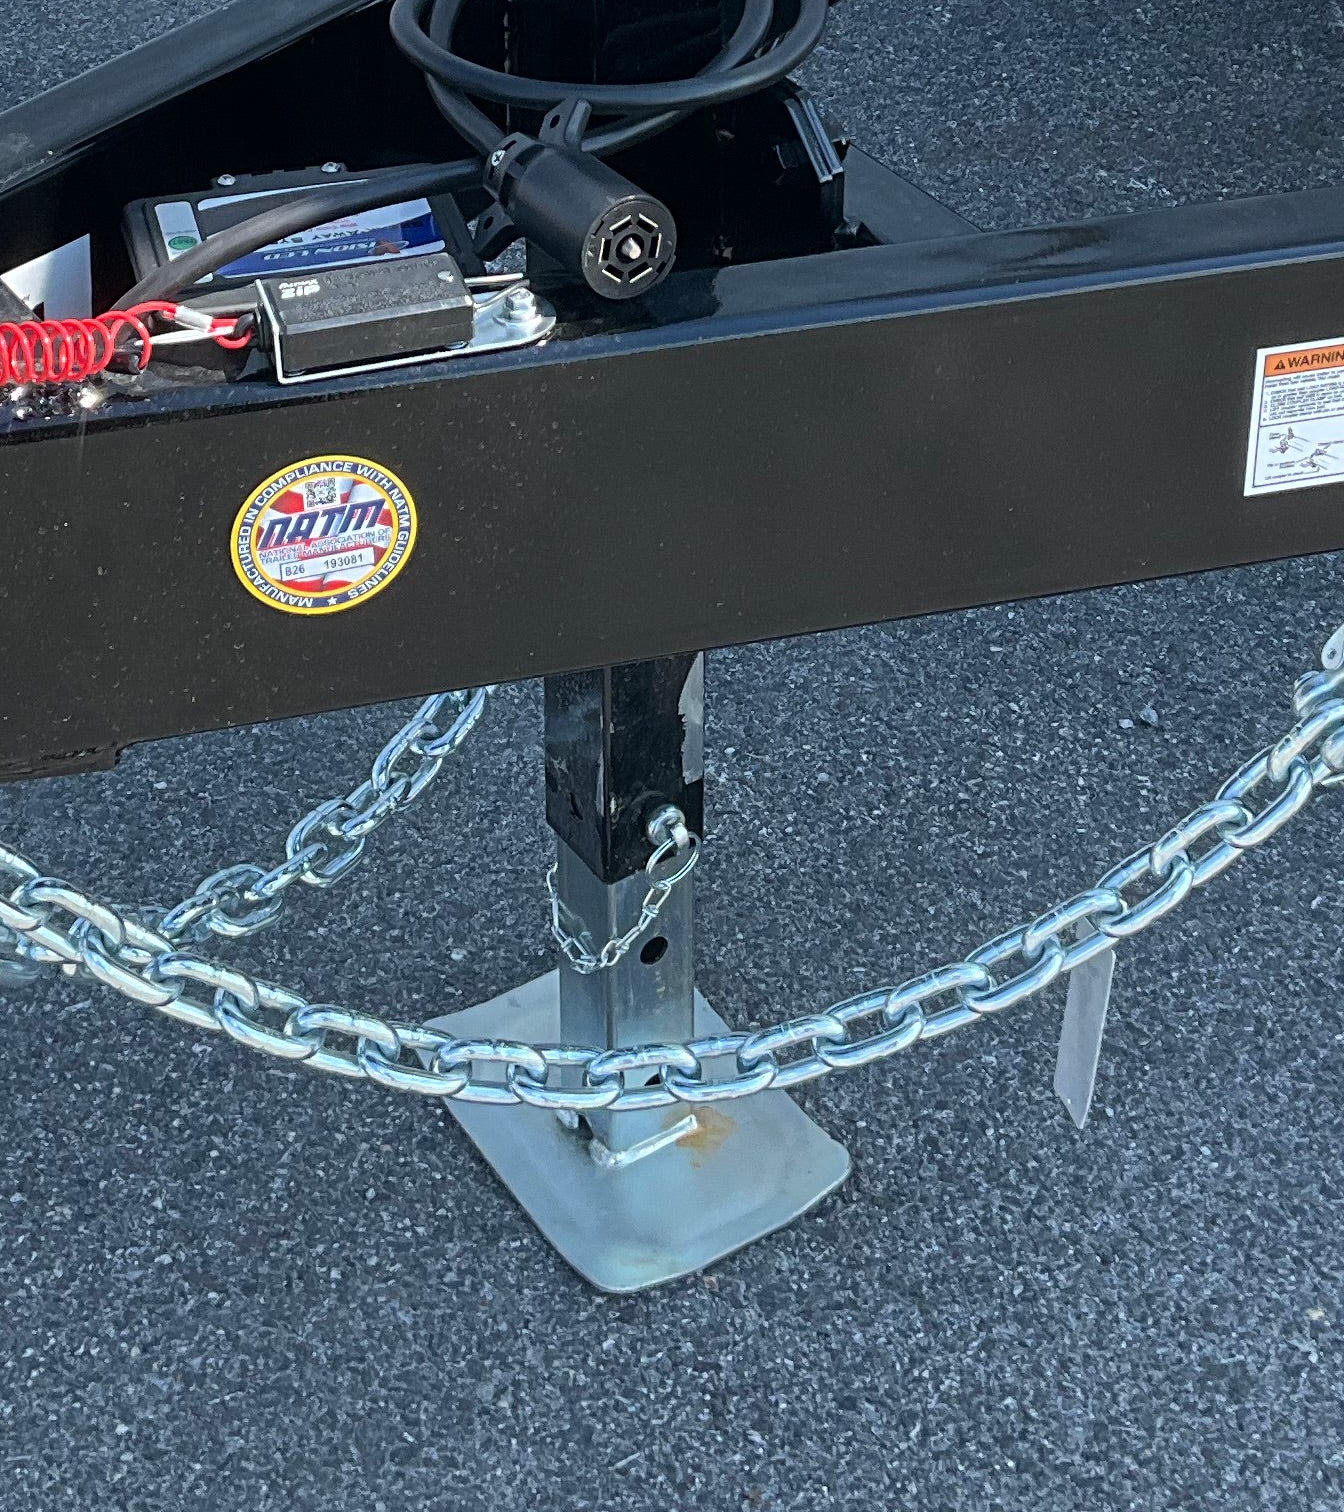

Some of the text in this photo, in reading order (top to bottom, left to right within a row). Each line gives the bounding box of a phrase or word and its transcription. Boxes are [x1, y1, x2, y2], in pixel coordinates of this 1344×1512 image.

[238, 461, 411, 608] MANUFACTURED IN COMPLIANCE WITH NATM GUIDELINES
[257, 498, 386, 551] NATM
[259, 527, 391, 559] NATIONAL ASSOCIATION OF
[260, 551, 301, 565] TRAILER
[285, 552, 364, 577] B26 193081
